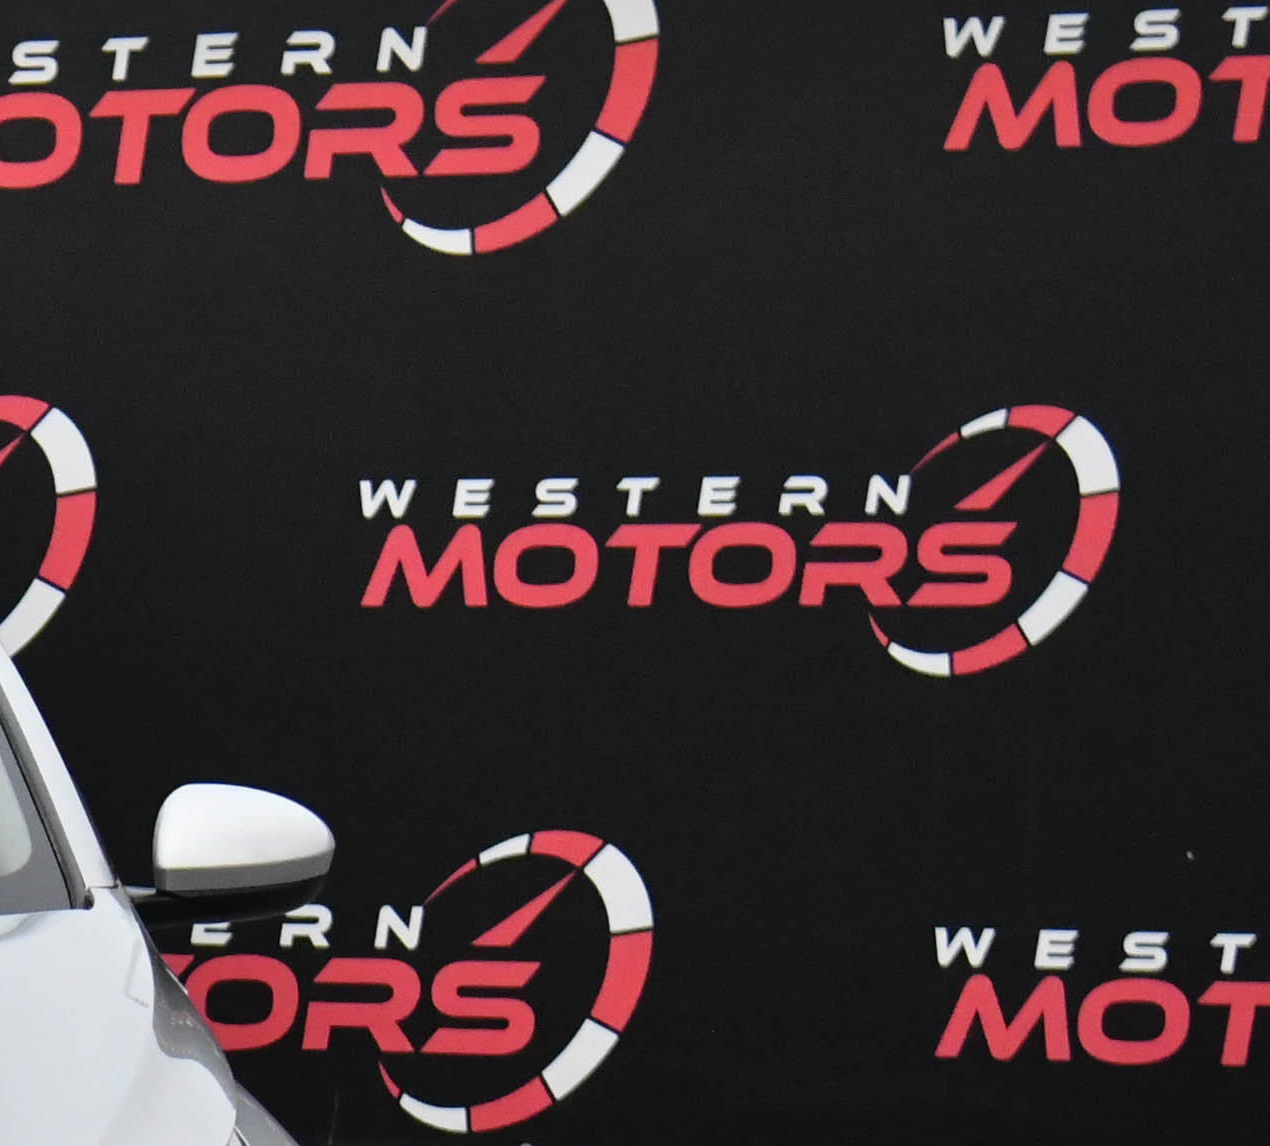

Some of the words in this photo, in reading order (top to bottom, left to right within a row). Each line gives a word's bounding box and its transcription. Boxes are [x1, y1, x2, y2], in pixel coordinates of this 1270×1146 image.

[359, 474, 911, 518] WESTERN
[361, 521, 1017, 609] MOTORS
[162, 954, 542, 1056] ORS
